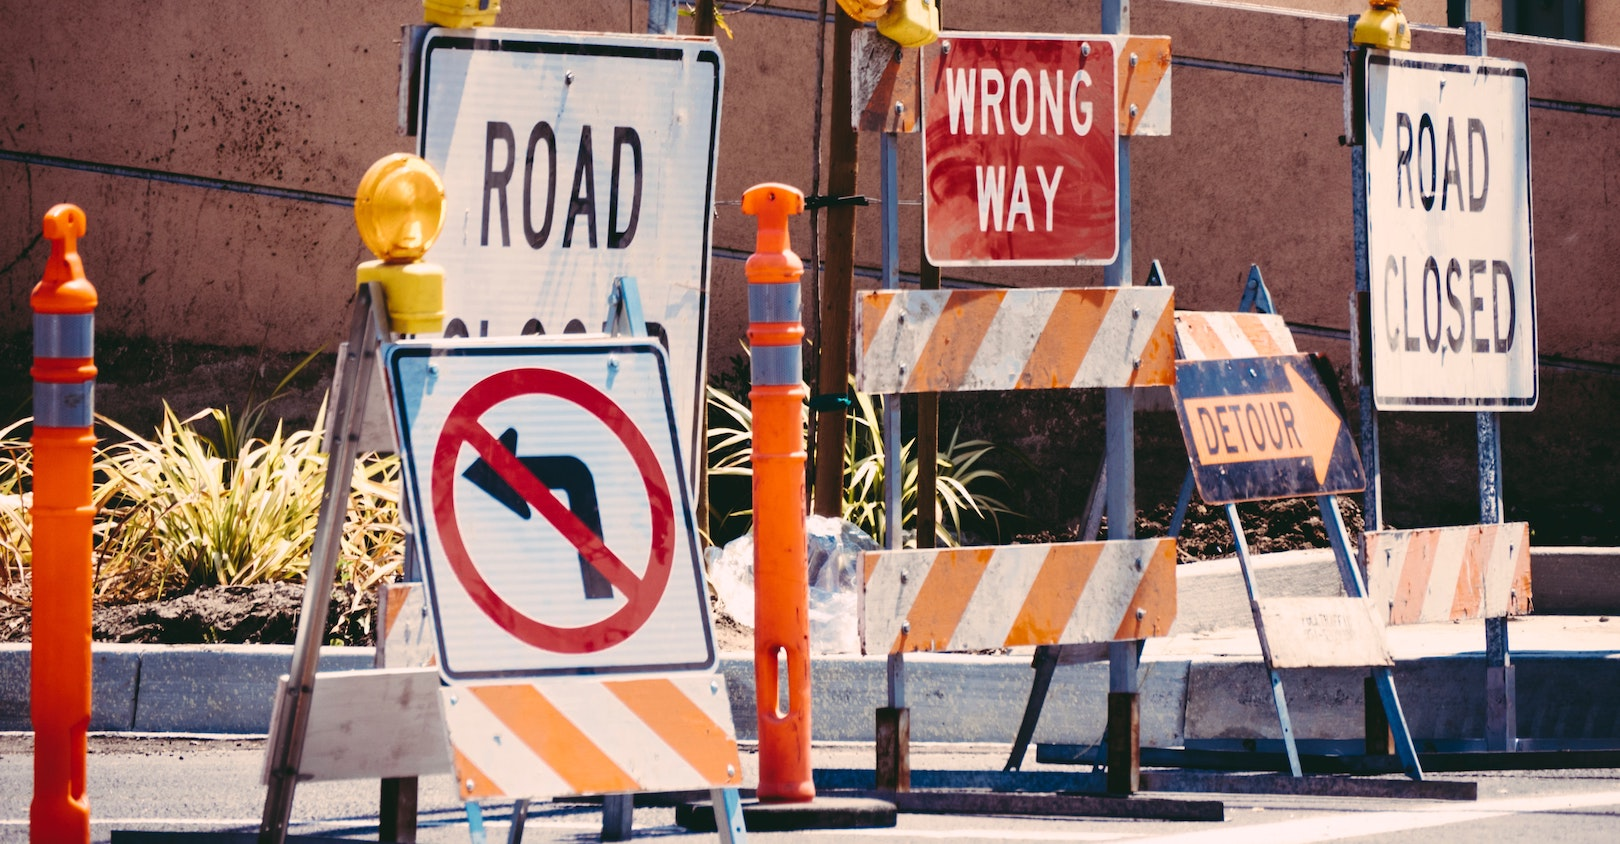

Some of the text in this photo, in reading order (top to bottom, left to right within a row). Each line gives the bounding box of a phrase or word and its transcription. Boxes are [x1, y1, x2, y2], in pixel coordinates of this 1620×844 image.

[946, 67, 1093, 136] WRONG
[480, 120, 643, 250] ROAD
[976, 165, 1064, 232] WAY
[1396, 112, 1490, 213] ROAD
[1384, 254, 1516, 354] CLOSED
[1197, 401, 1303, 455] DETOUR
